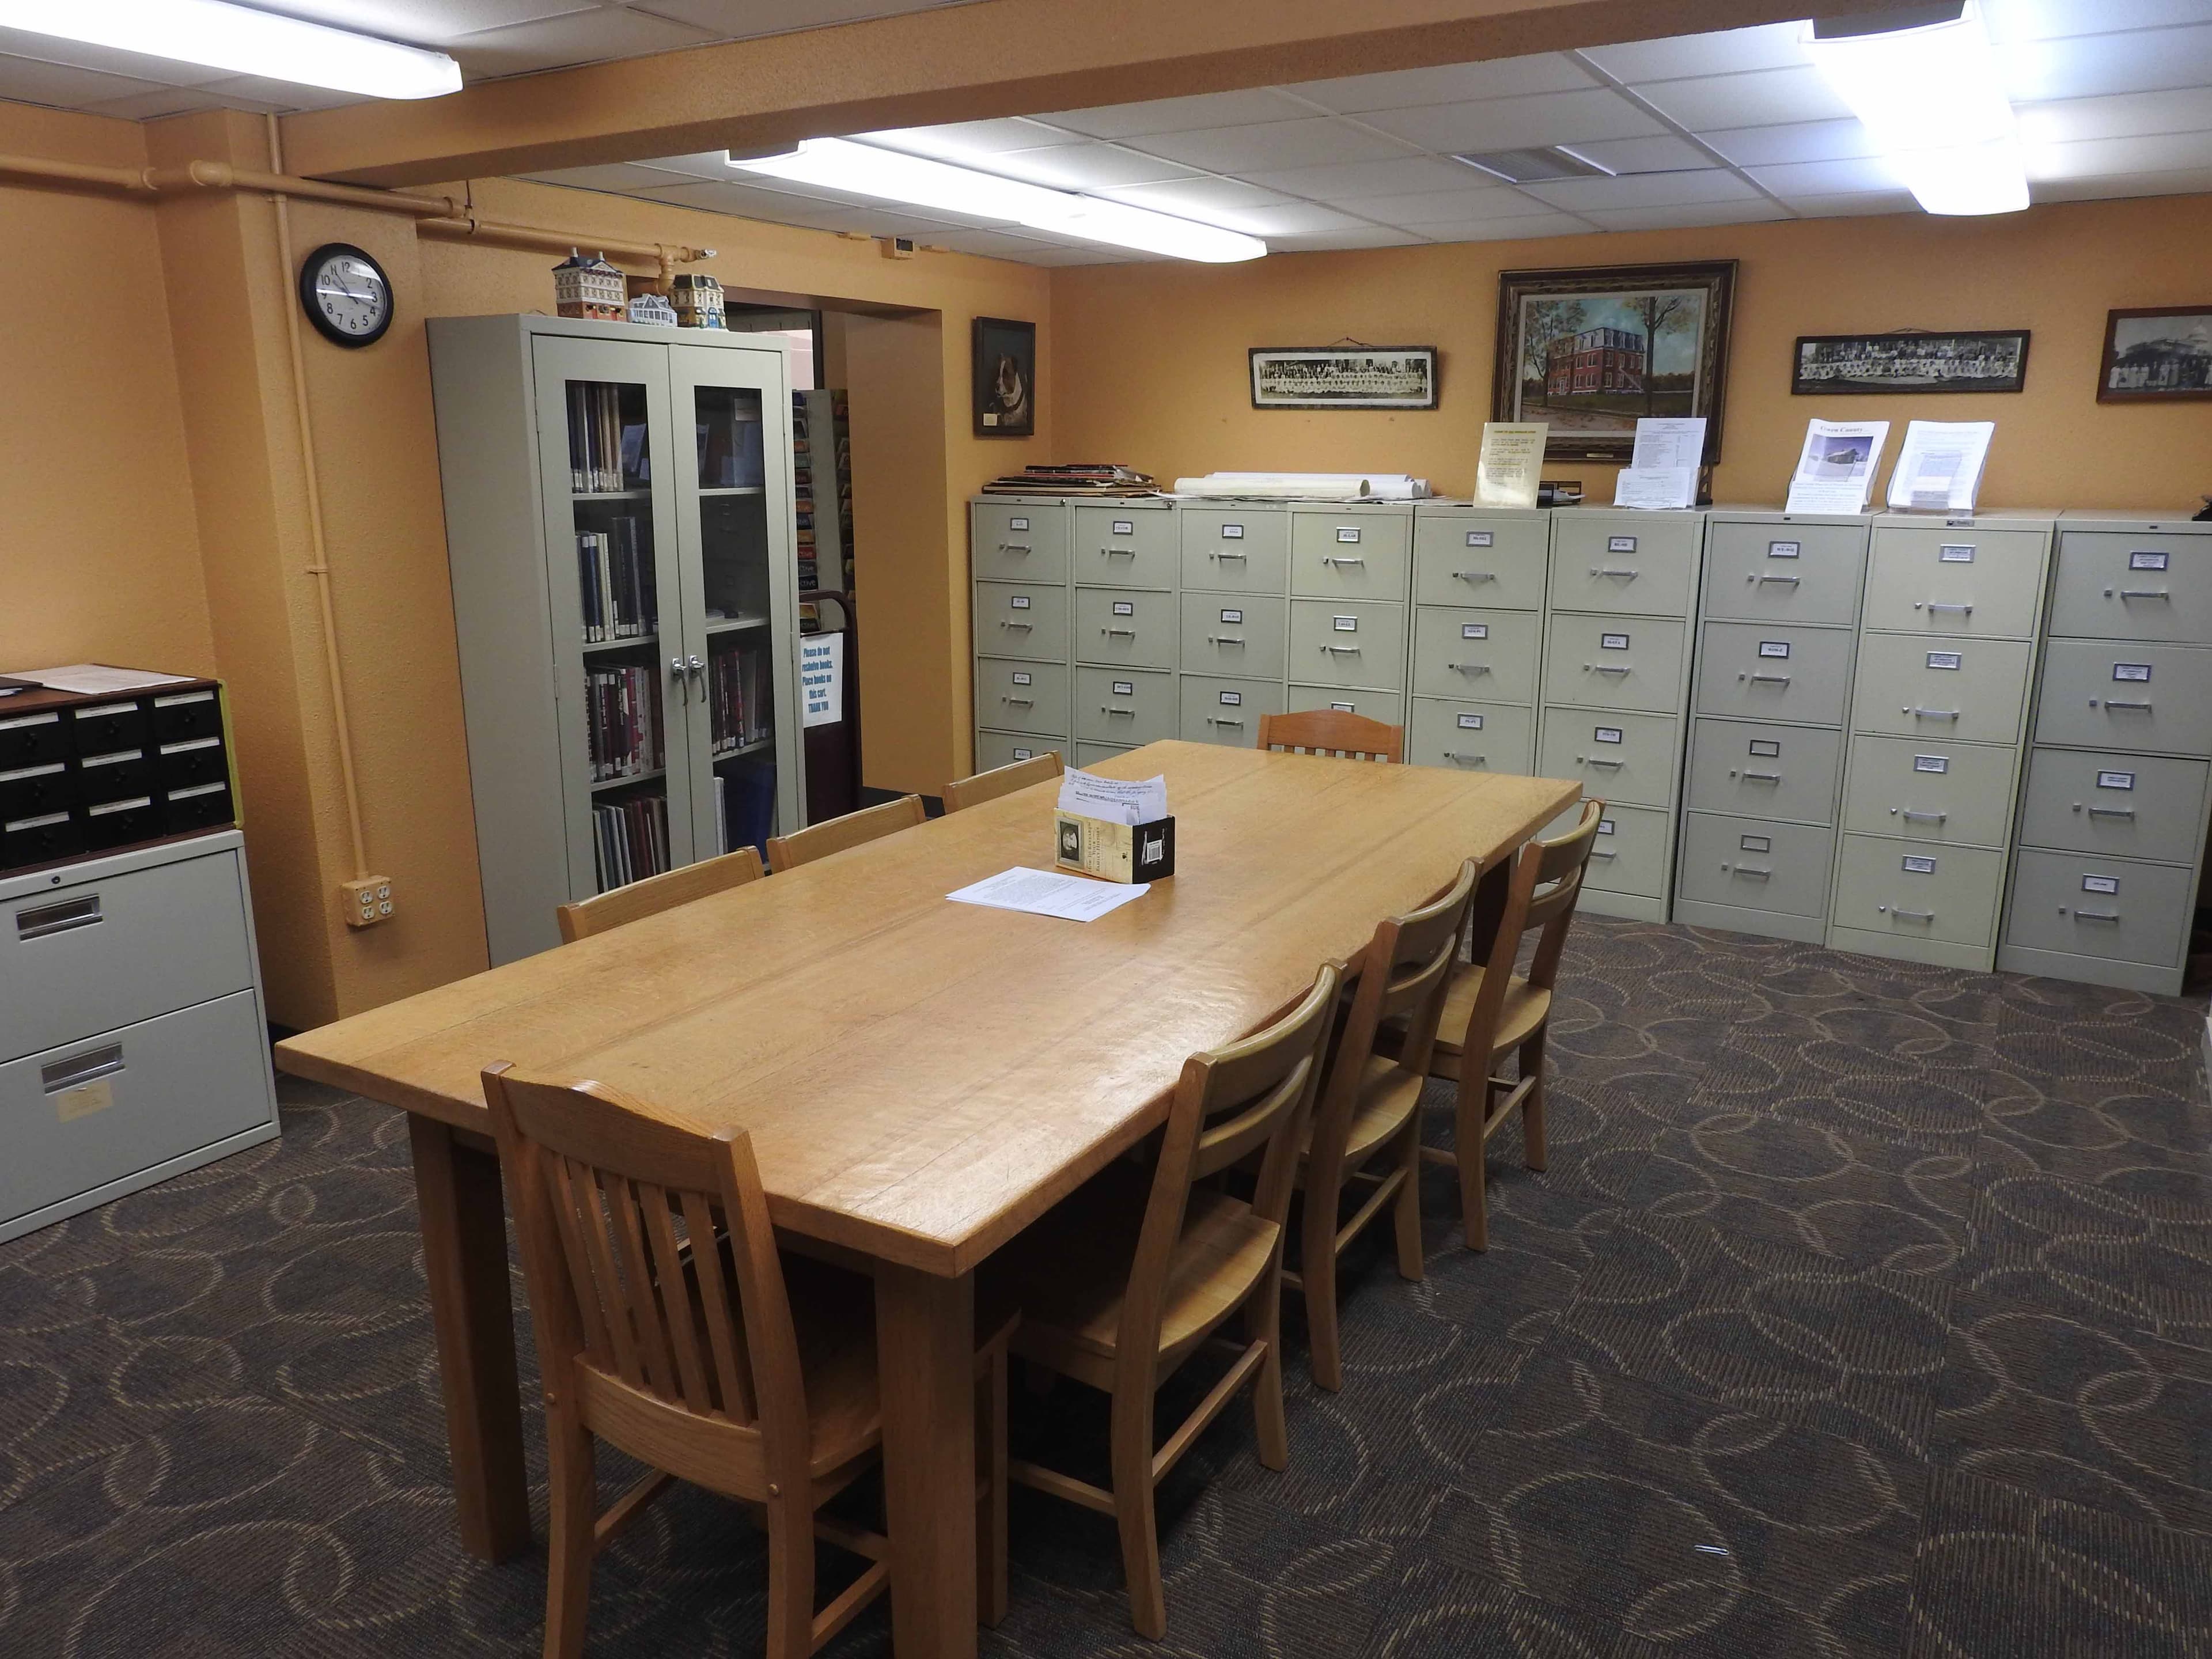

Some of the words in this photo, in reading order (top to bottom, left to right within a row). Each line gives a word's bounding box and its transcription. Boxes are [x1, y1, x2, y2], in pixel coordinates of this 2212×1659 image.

[342, 261, 350, 273] 12
[321, 274, 330, 286] 10
[366, 278, 373, 289] 2
[372, 291, 378, 303] 3
[327, 302, 334, 314] 8
[370, 306, 376, 317] 4
[337, 313, 343, 325] 7
[350, 319, 357, 329] 6
[362, 315, 369, 326] 5
[804, 647, 817, 658] Please
[817, 646, 823, 656] do
[802, 676, 813, 686] Place
[814, 675, 826, 685] books
[826, 674, 832, 683] on
[809, 688, 817, 699] this
[808, 702, 821, 714] THANK
[821, 700, 829, 712] YOU
